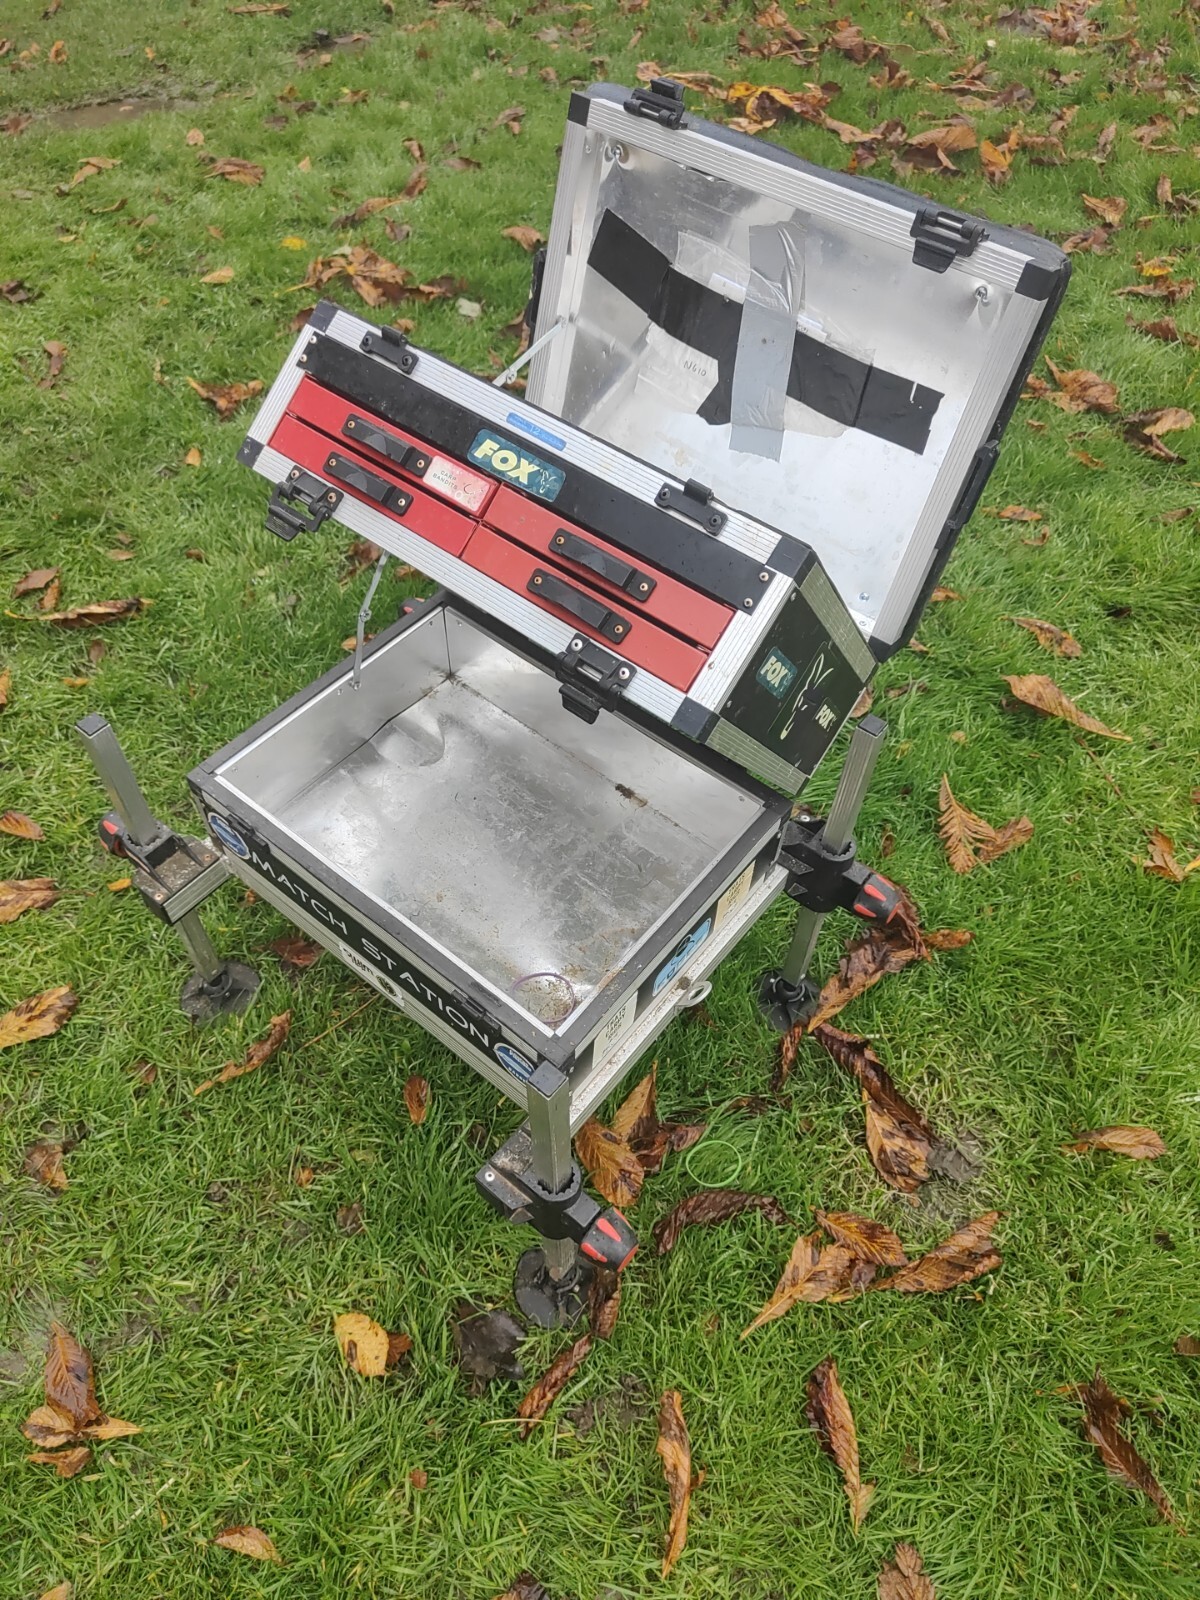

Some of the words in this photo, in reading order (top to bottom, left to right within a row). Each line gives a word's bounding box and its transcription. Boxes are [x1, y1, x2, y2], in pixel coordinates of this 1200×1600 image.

[440, 470, 457, 481] CARP
[473, 438, 541, 485] FOX
[432, 472, 458, 490] BANDITS
[760, 655, 790, 688] FOX
[815, 704, 835, 730] FOX
[252, 851, 348, 936] MATCH
[361, 937, 490, 1048] STATION
